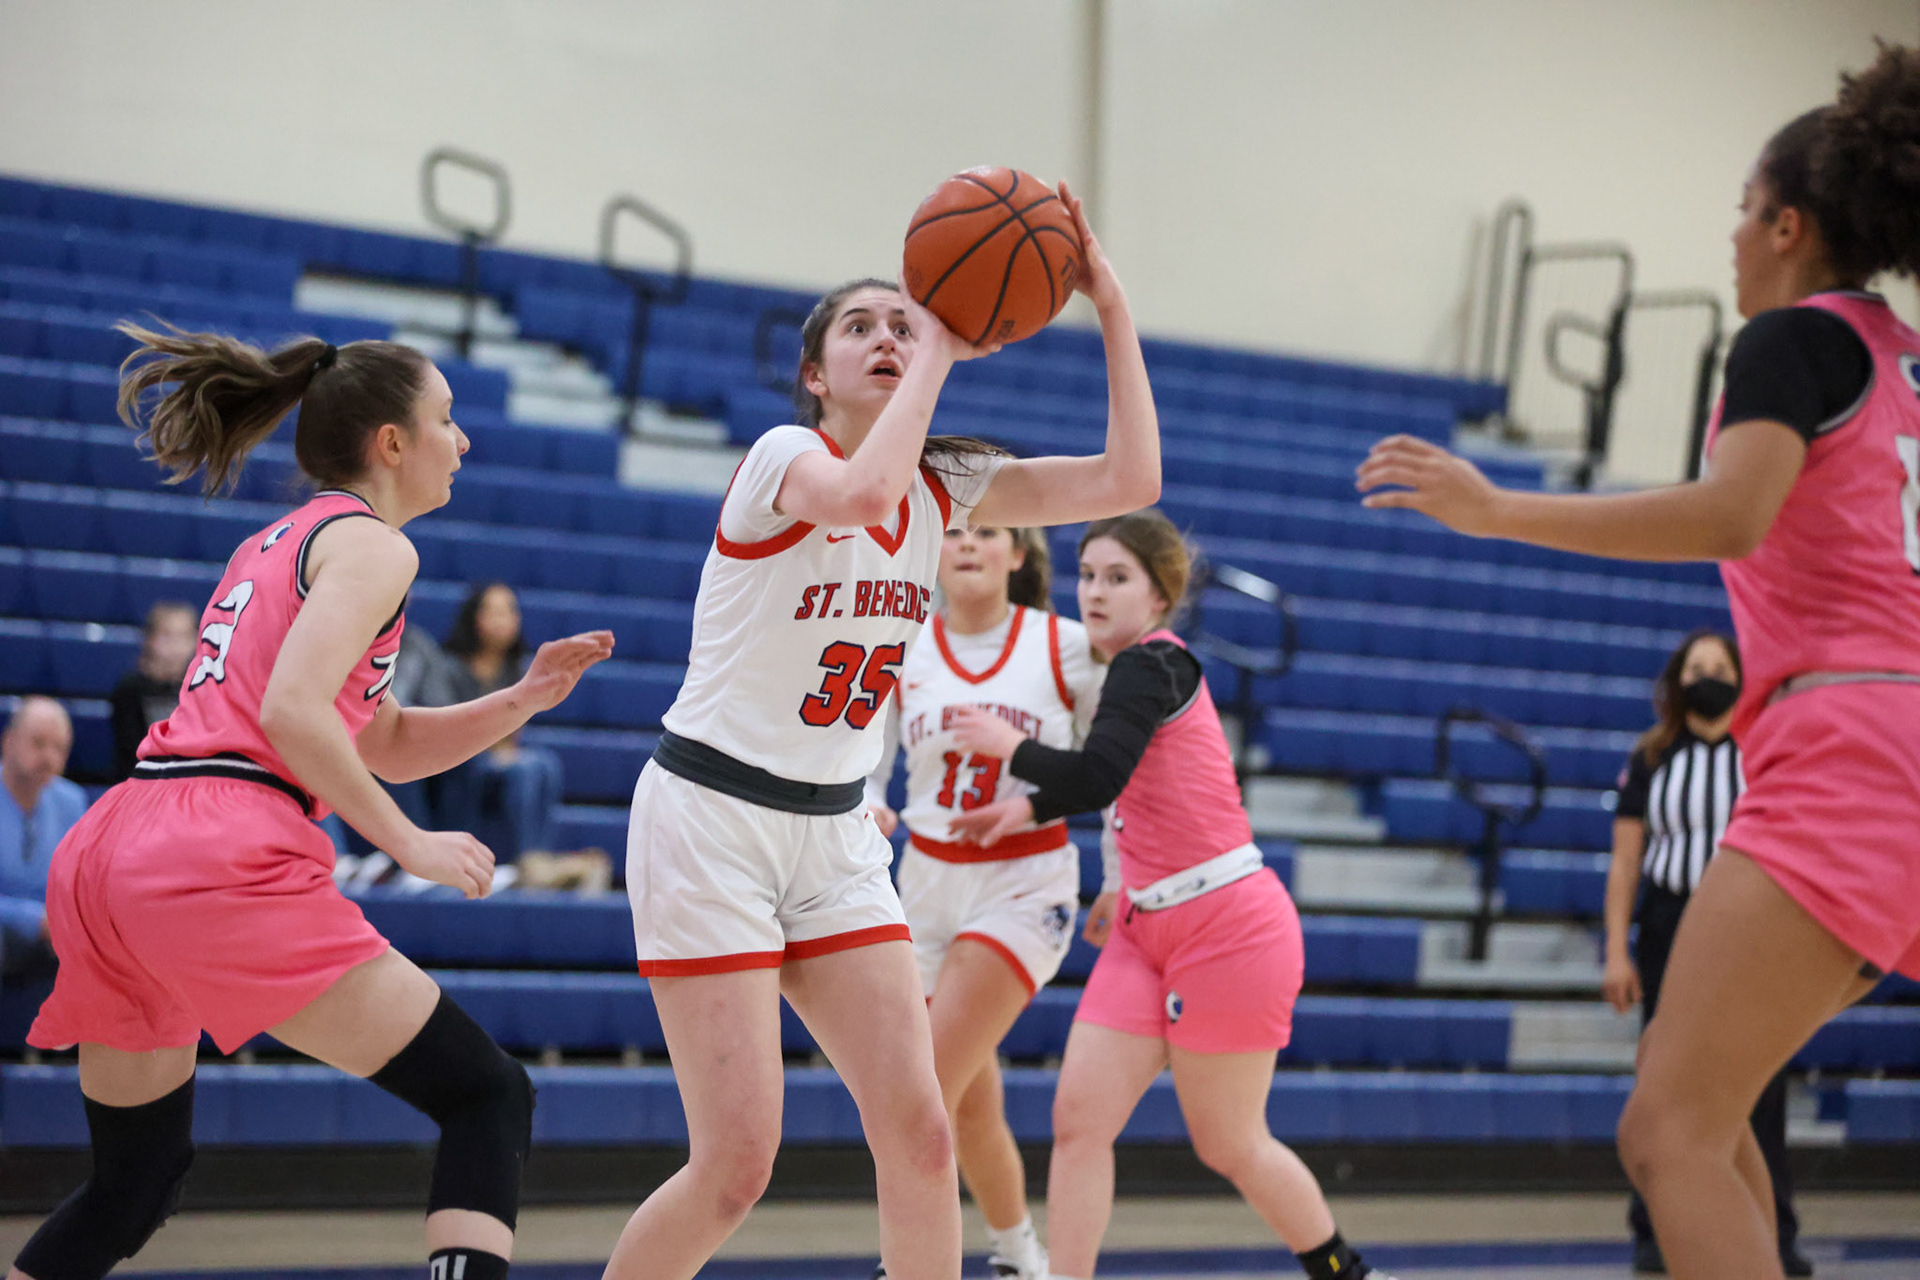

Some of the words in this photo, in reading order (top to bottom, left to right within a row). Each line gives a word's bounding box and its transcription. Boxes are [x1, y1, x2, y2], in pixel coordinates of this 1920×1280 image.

[794, 582, 843, 620] ST.
[798, 640, 906, 730] 35
[937, 751, 1002, 811] 13
